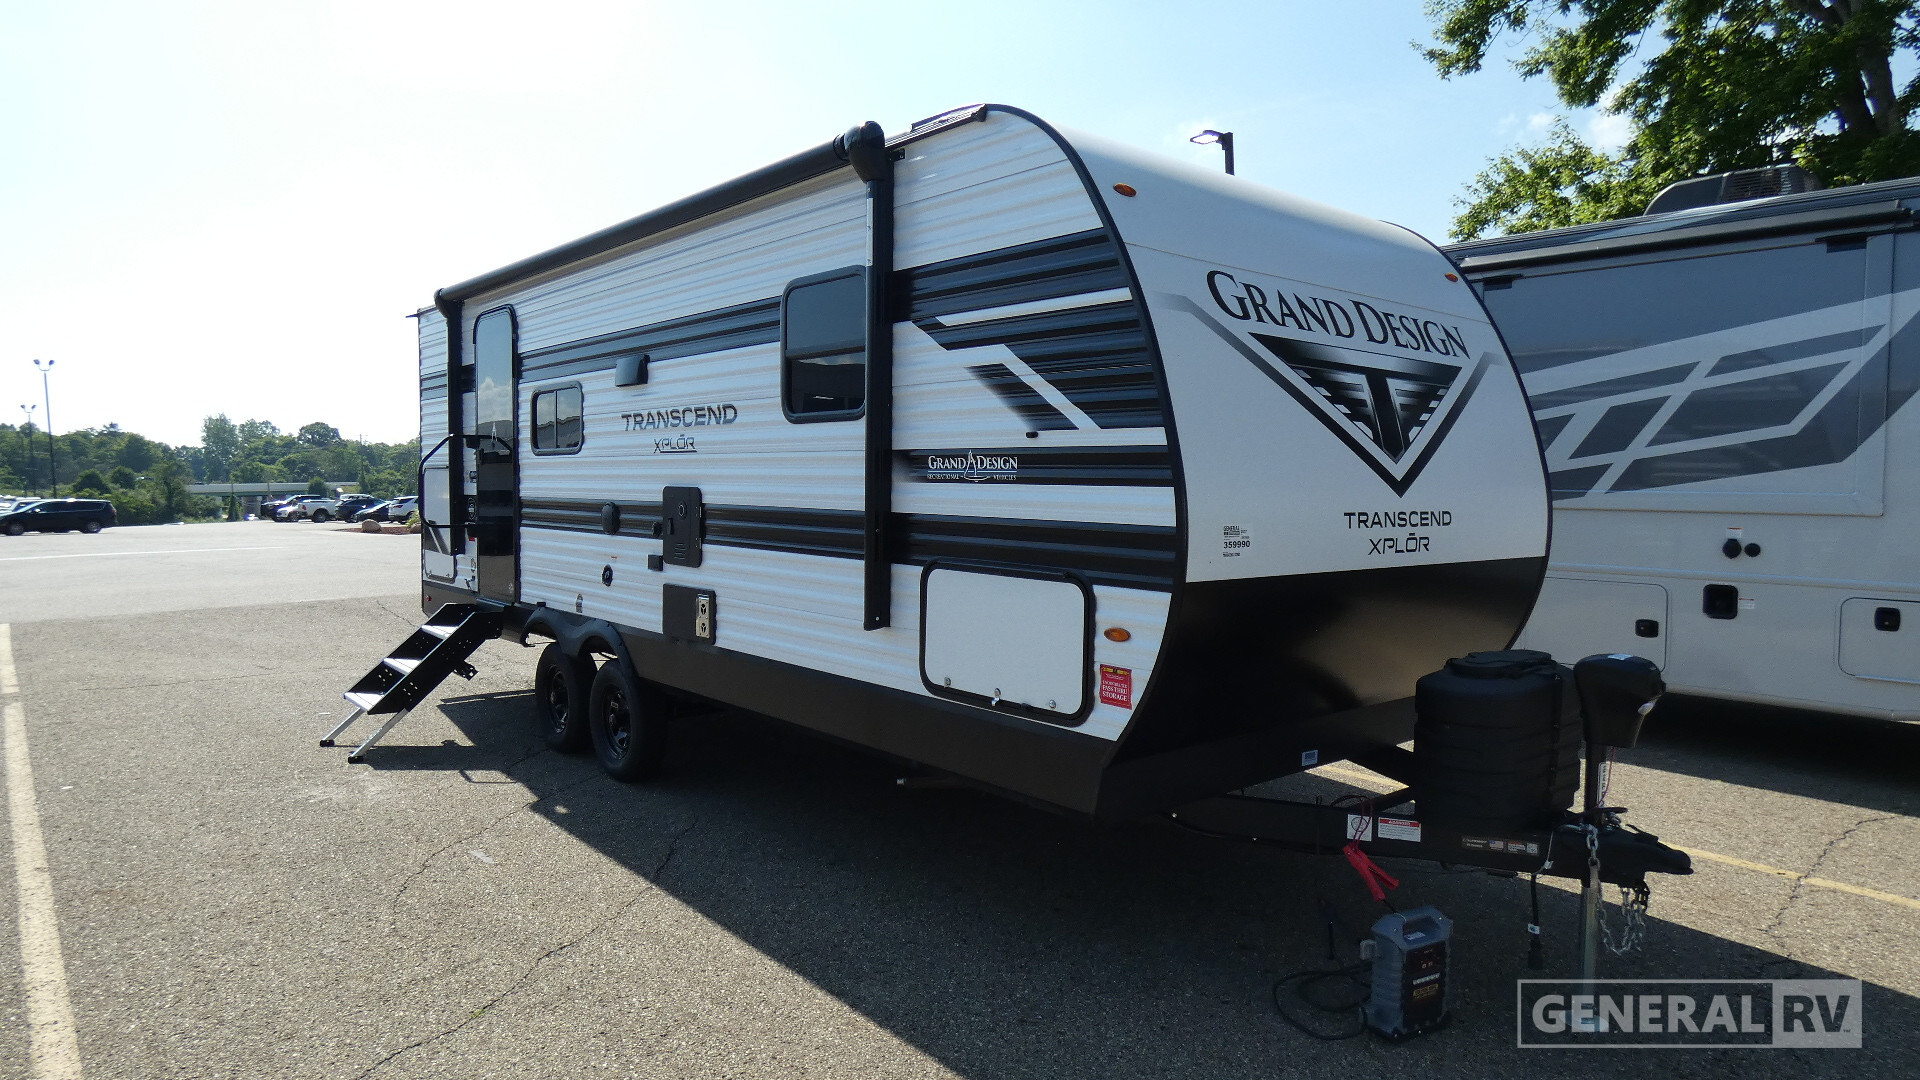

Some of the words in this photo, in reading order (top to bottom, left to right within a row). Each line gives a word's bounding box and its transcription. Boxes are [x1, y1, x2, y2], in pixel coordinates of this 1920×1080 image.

[1206, 270, 1355, 338] GRAND
[1348, 299, 1471, 359] DESIGN
[621, 403, 738, 431] TRANSCEND
[928, 455, 967, 469] GRAND
[976, 455, 1018, 469] DESIGN
[1343, 510, 1452, 529] TRANSCEND
[1223, 540, 1250, 549] 359990
[1102, 691, 1128, 701] STORAGE
[1114, 686, 1128, 695] THRU
